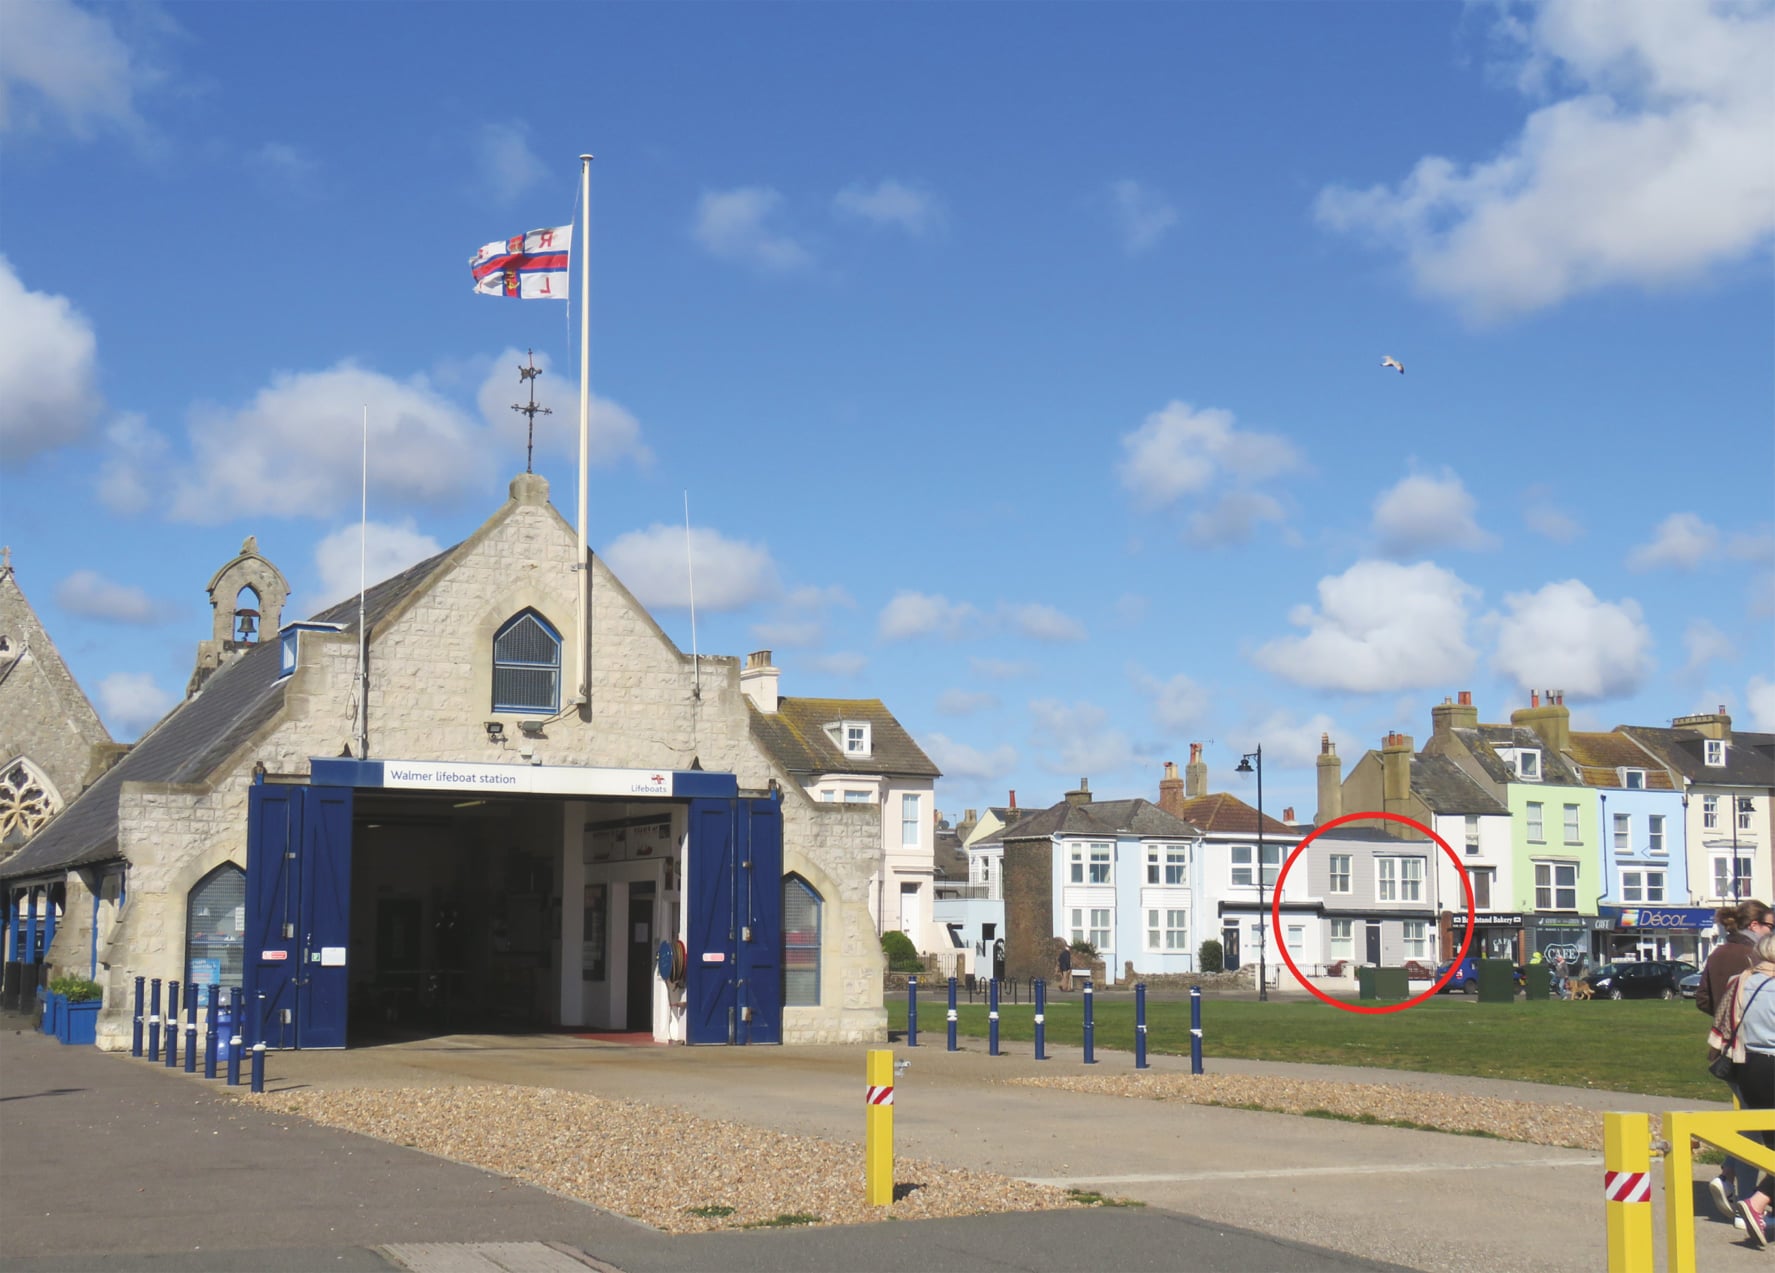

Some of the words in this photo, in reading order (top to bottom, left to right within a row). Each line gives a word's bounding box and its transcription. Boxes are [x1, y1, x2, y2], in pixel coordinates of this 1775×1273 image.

[390, 770, 432, 781] Walmer
[436, 771, 476, 783] lifeboat
[479, 774, 516, 784] station
[631, 784, 667, 793] Lifeboats
[1461, 916, 1492, 924] Bastand
[1493, 916, 1513, 925] Bakery
[1639, 910, 1687, 927] Décor
[1547, 948, 1576, 960] CAFE
